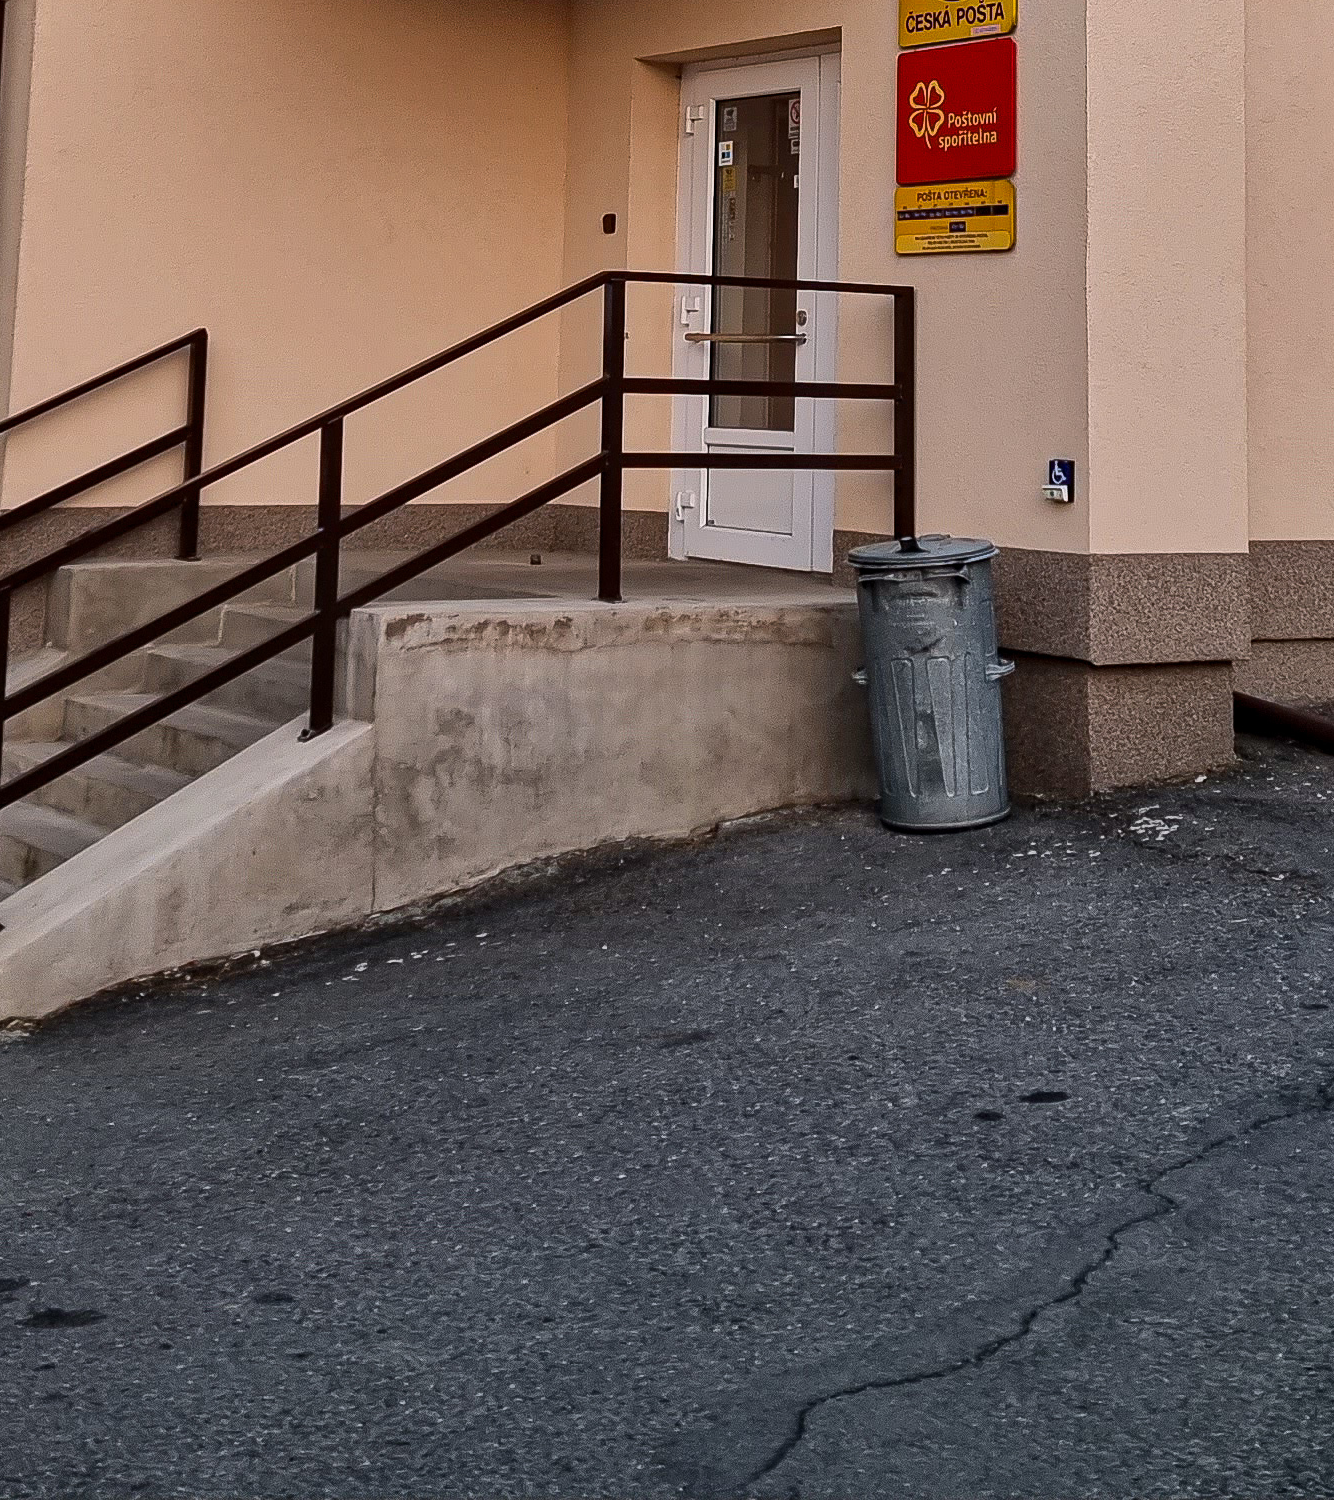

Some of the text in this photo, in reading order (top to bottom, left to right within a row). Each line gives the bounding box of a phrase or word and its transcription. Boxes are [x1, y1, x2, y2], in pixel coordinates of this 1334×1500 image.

[905, 0, 1004, 33] ČESKÁ POŠTA
[948, 107, 997, 128] Poštovní
[938, 128, 997, 151] spořitelna
[916, 189, 941, 202] POŠTA
